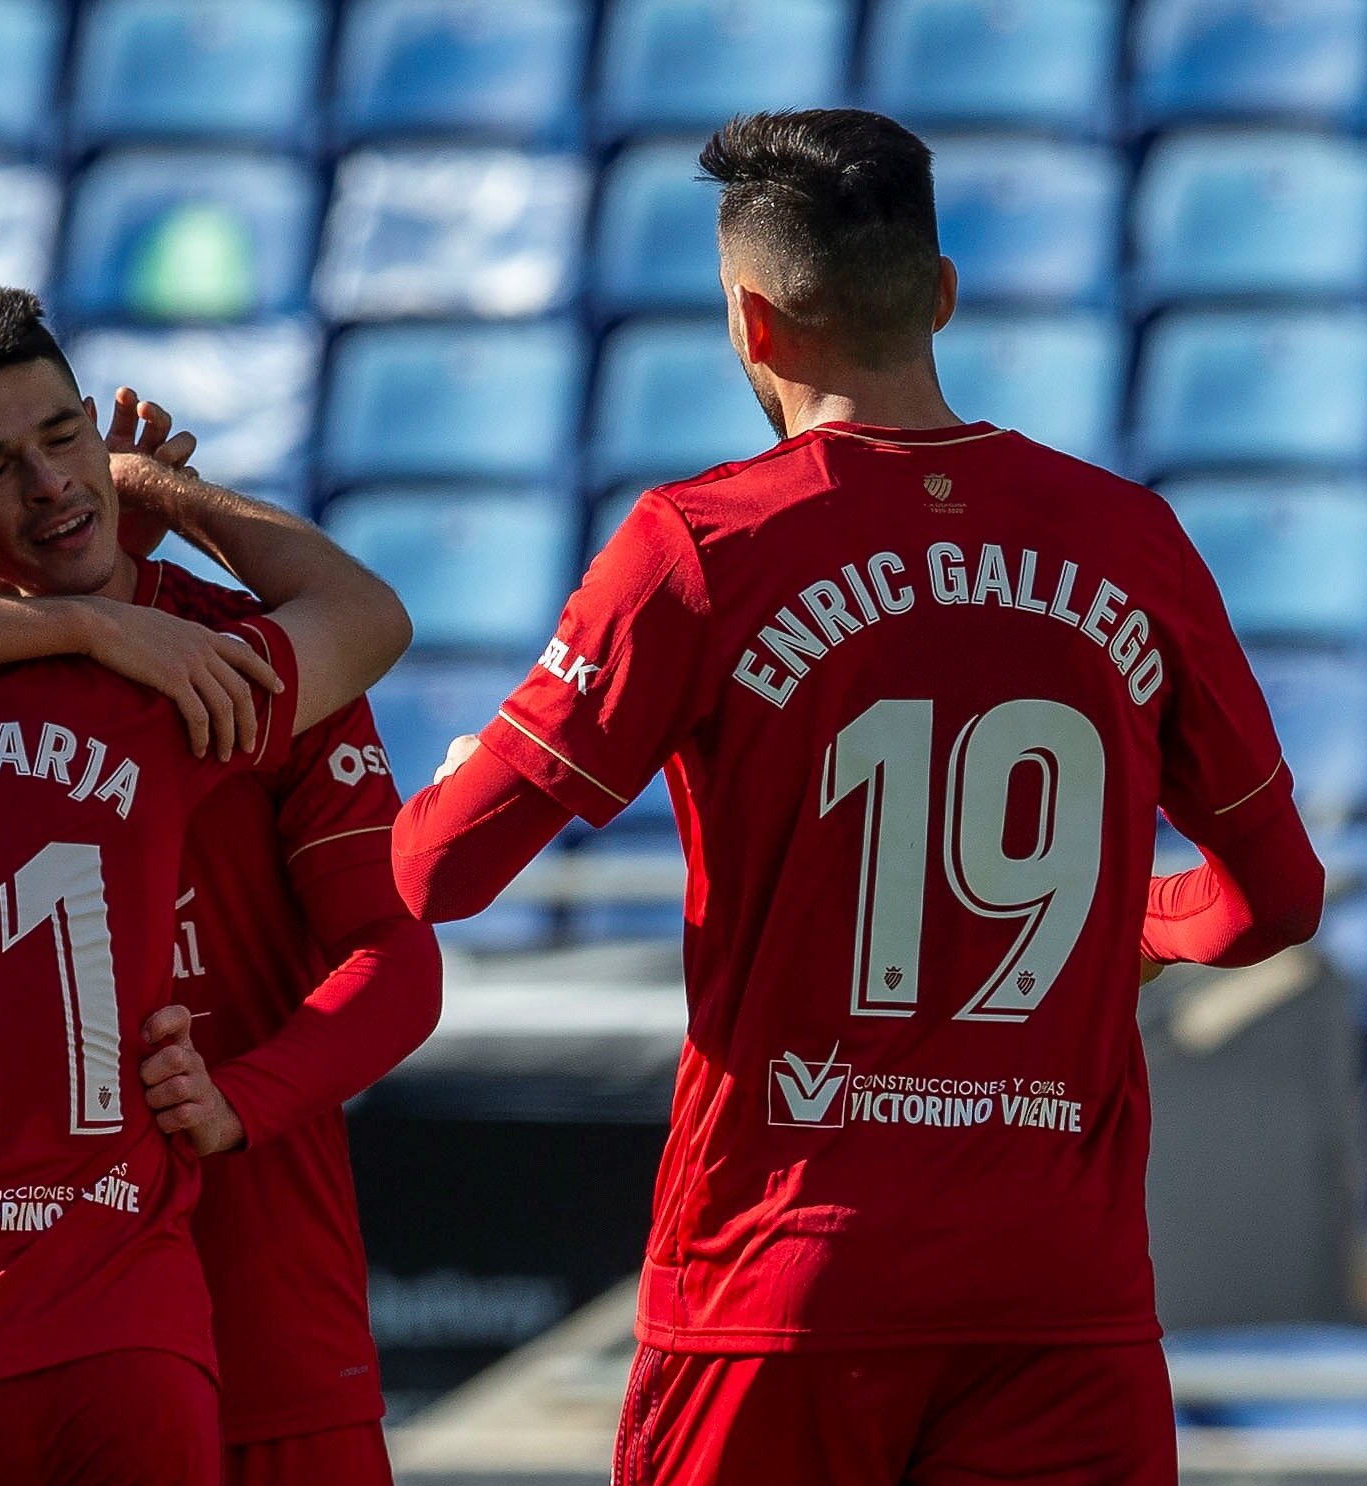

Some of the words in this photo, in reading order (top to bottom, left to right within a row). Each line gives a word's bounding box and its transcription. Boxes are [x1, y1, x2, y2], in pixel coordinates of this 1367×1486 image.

[733, 551, 915, 709] ENRIC
[927, 541, 1164, 706] GALLEGO
[820, 699, 1106, 1023] 19
[850, 1090, 993, 1127] VICTORINO
[852, 1074, 1006, 1096] CONSTRUCCIONES
[1013, 1078, 1025, 1093] Y
